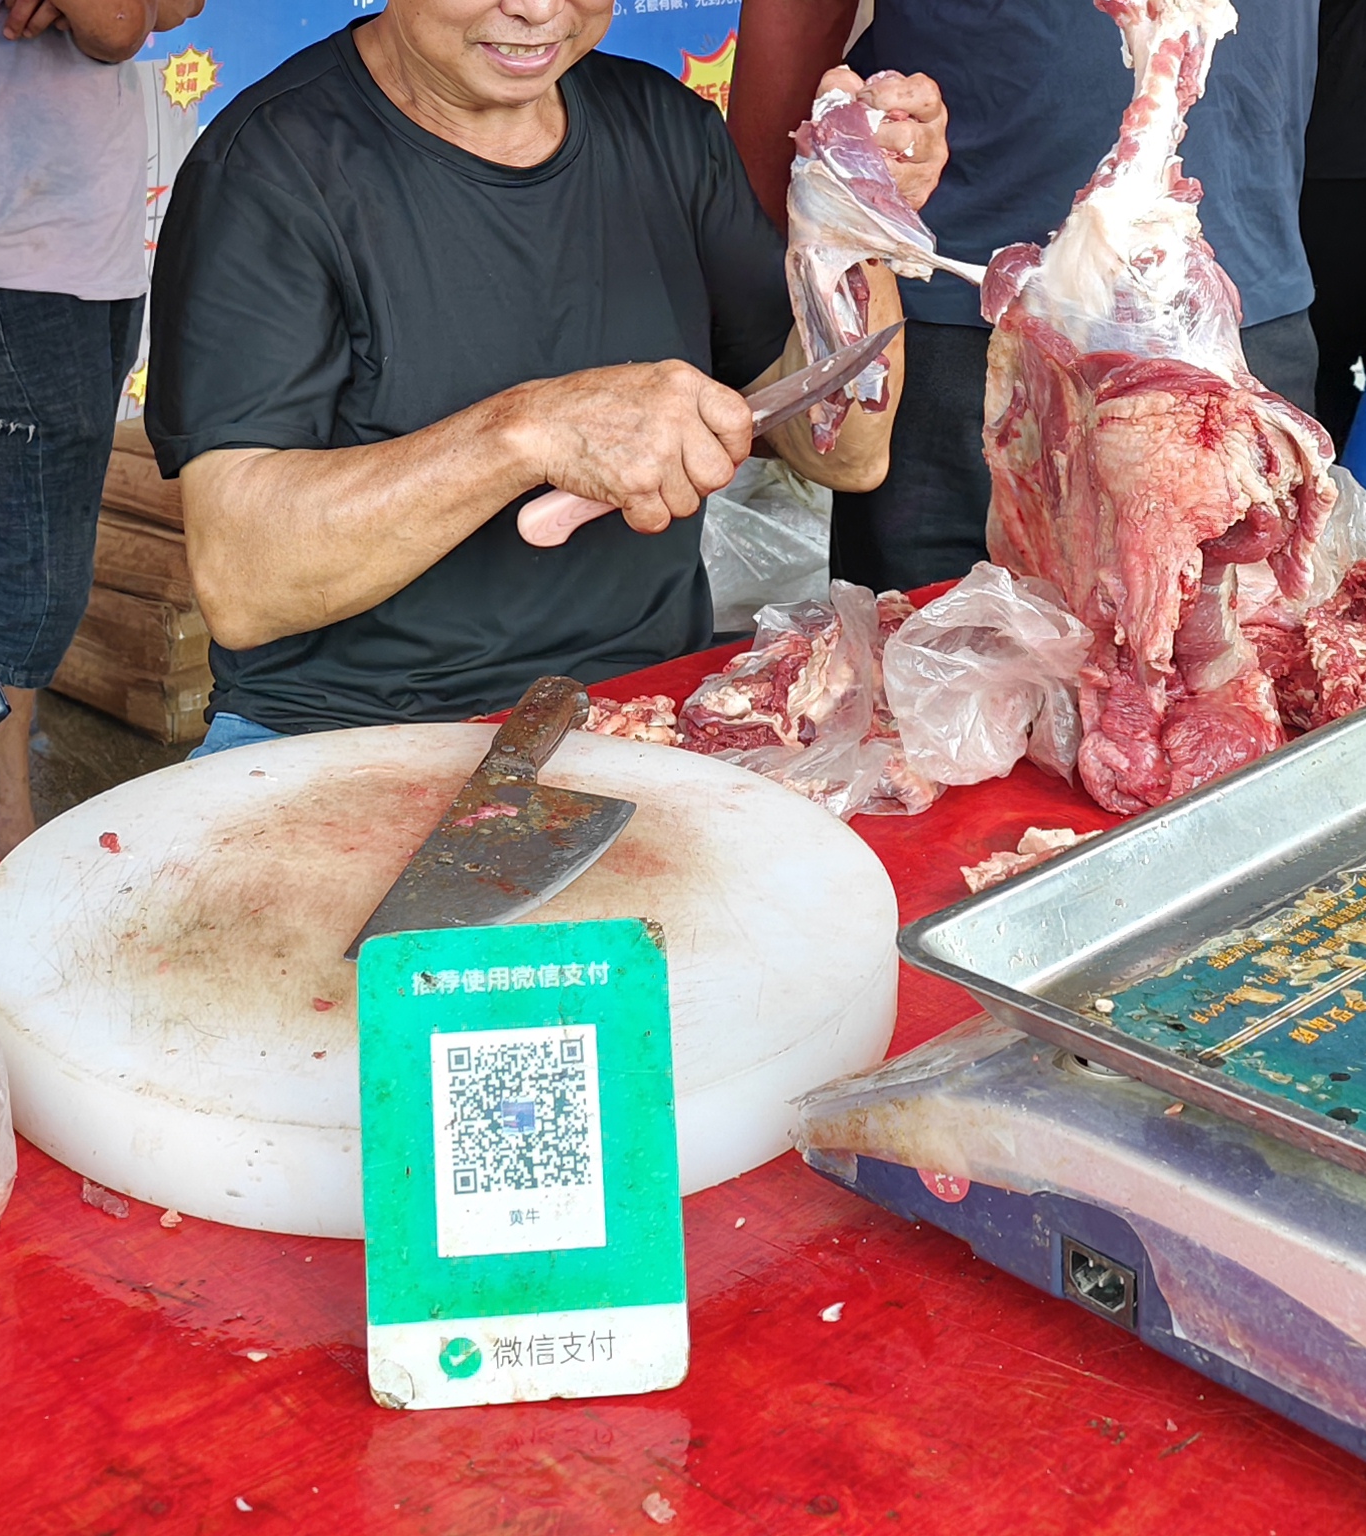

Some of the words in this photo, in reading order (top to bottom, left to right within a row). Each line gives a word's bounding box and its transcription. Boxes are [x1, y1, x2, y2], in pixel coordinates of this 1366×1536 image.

[411, 960, 610, 995] 推荐使用微信支付
[492, 1329, 616, 1370] 微信支付
